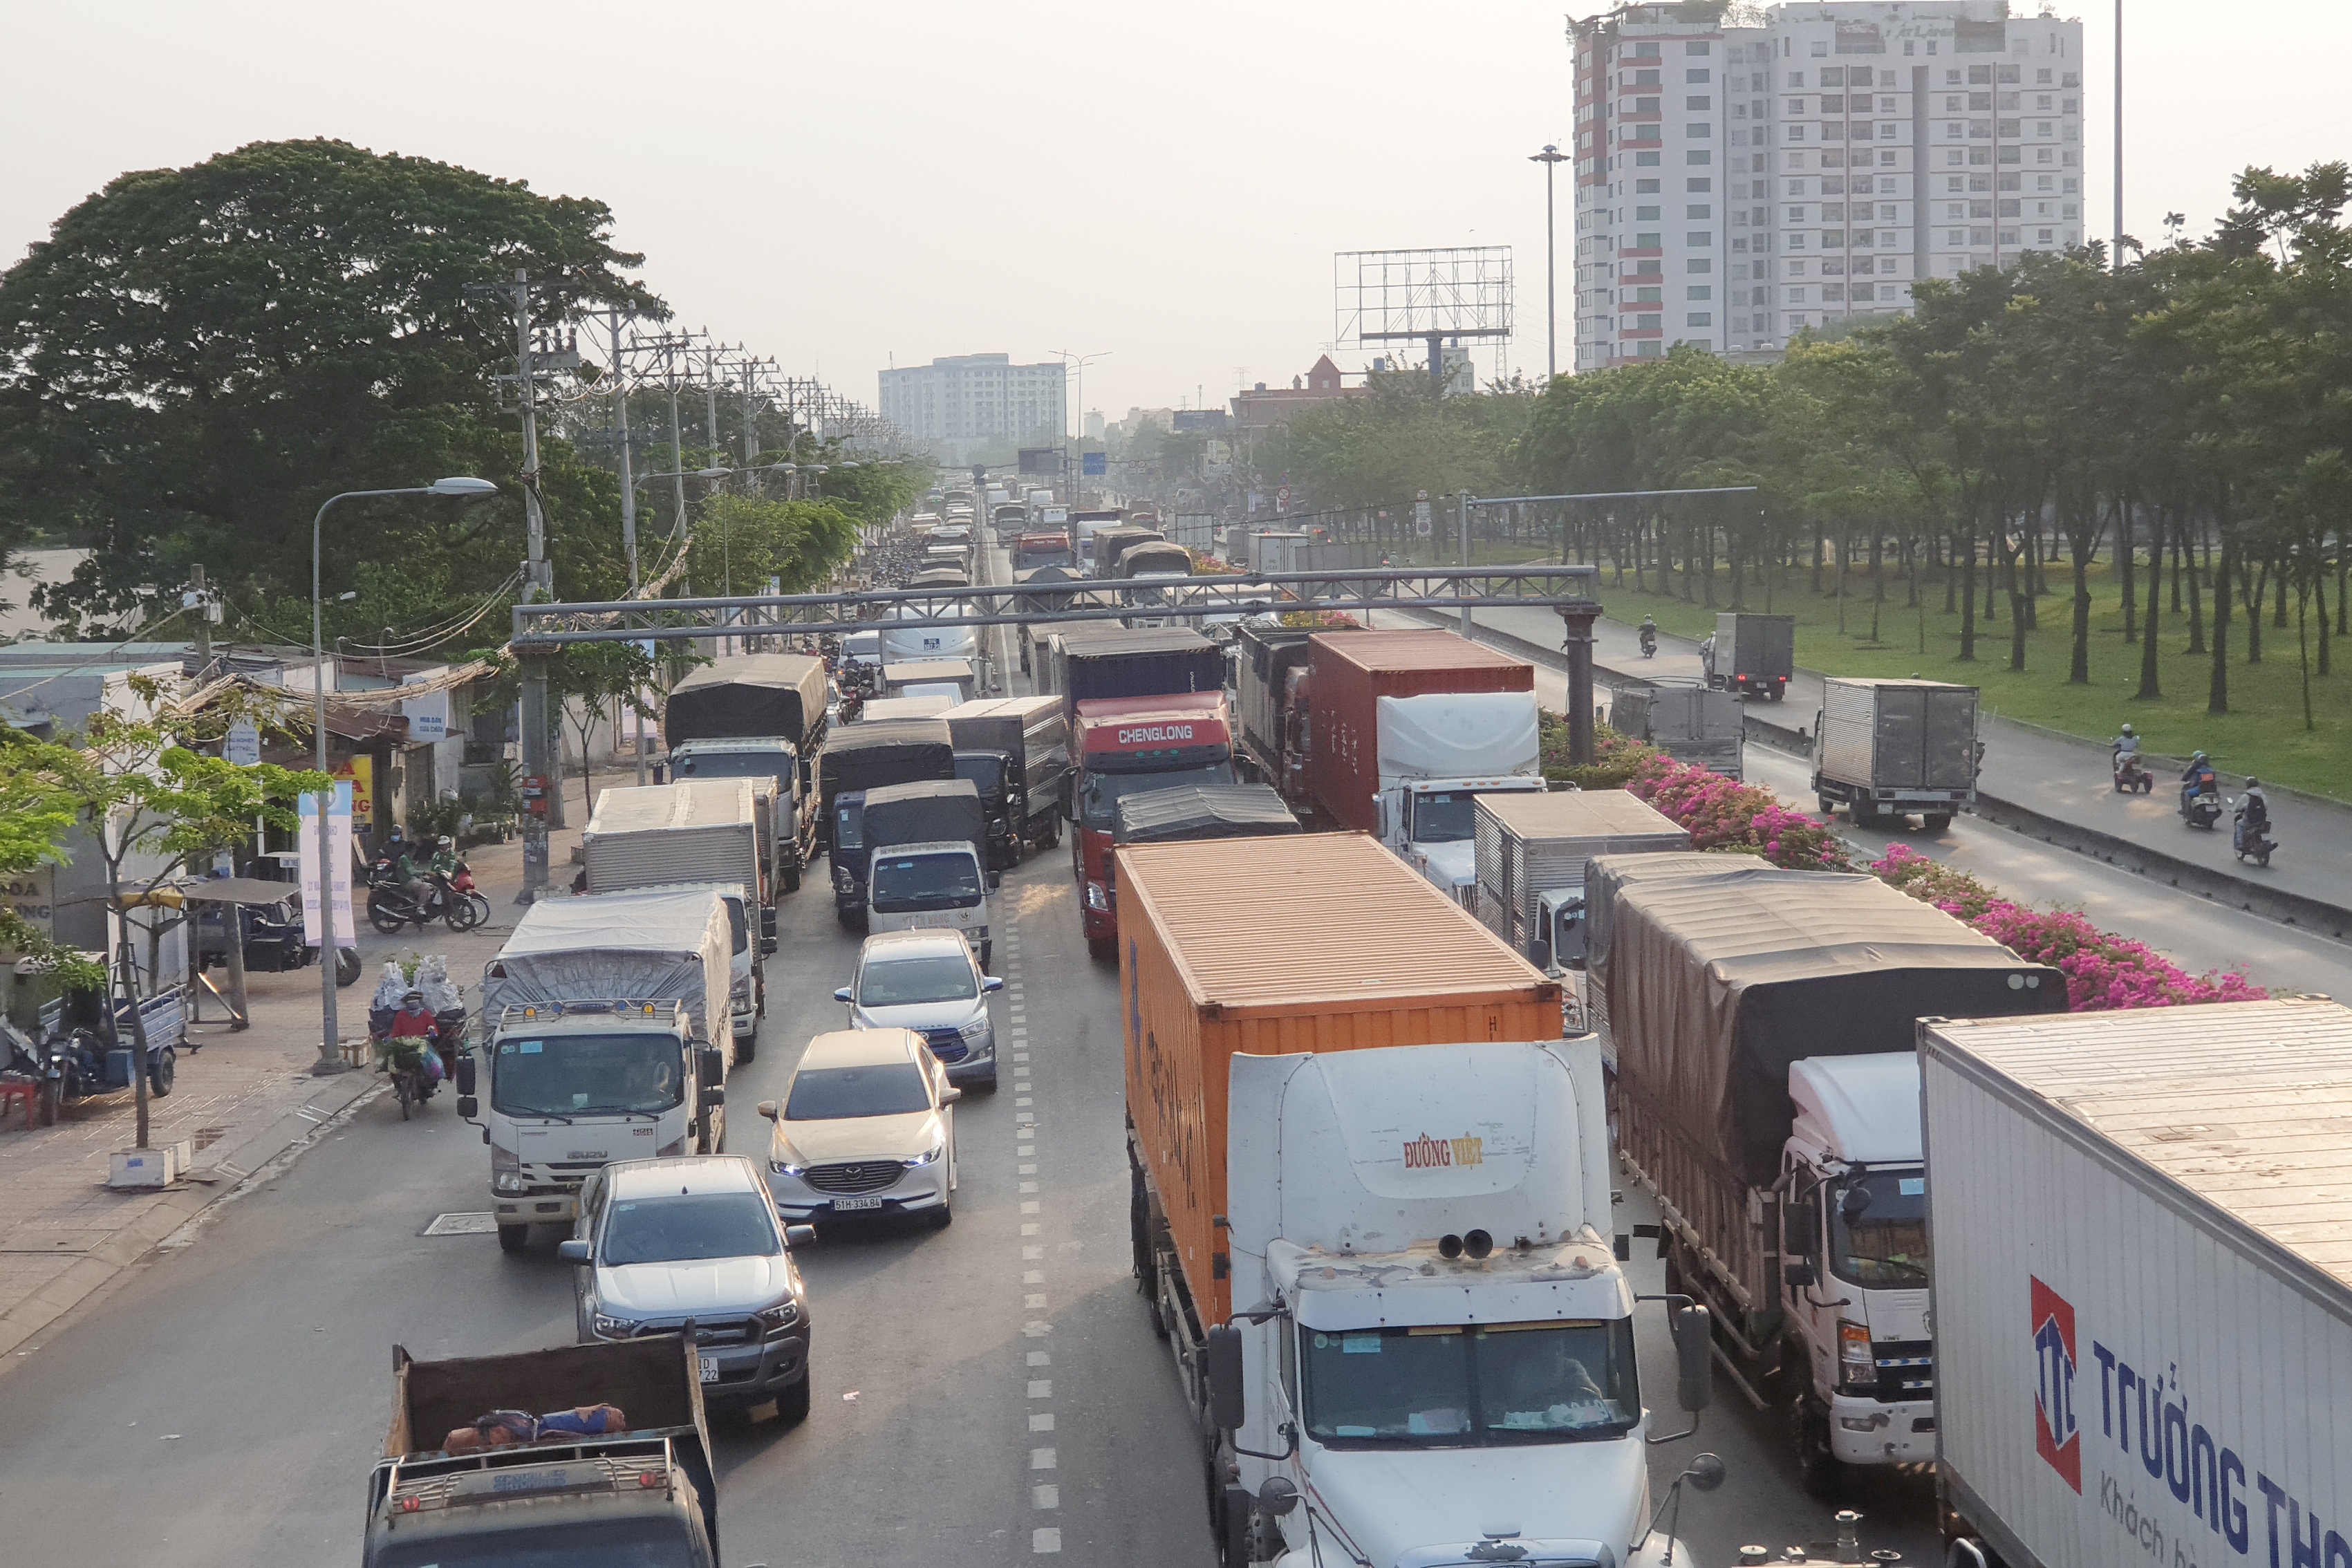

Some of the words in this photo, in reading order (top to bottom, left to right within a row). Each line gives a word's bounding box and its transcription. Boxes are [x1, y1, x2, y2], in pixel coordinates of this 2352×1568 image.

[1119, 725, 1193, 744] CHENGLONG
[567, 1150, 608, 1159] ISUZU
[1403, 1132, 1450, 1168] ĐƯỜNG
[1450, 1130, 1483, 1170] VIỆT
[2101, 1471, 2164, 1562] Khách
